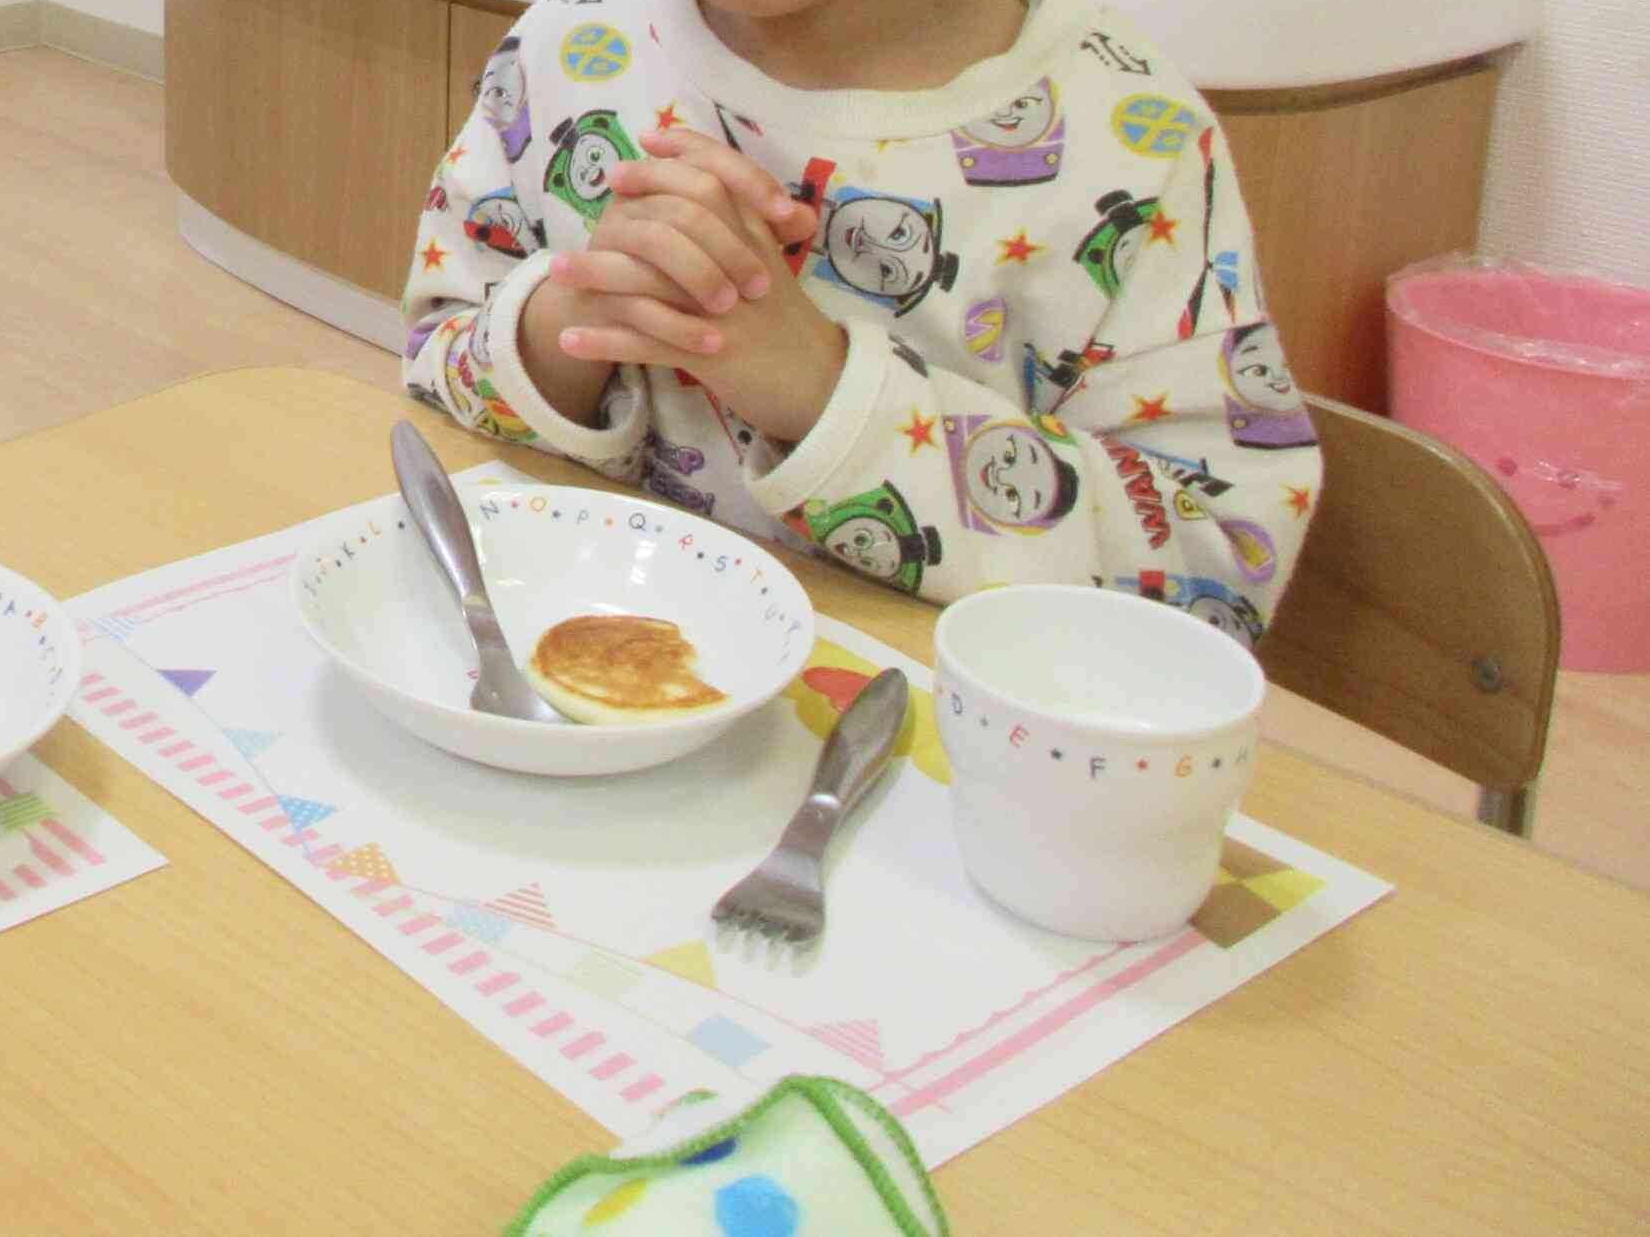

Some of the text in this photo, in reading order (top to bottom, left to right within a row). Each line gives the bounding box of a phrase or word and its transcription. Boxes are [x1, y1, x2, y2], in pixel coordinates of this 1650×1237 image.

[479, 499, 500, 520] N
[529, 496, 547, 514] O
[576, 509, 590, 524] P
[628, 512, 648, 532] Q
[714, 555, 728, 573] S
[2, 599, 16, 616] A
[1008, 723, 1030, 748] E
[1089, 756, 1107, 779] F
[1174, 753, 1193, 779] G
